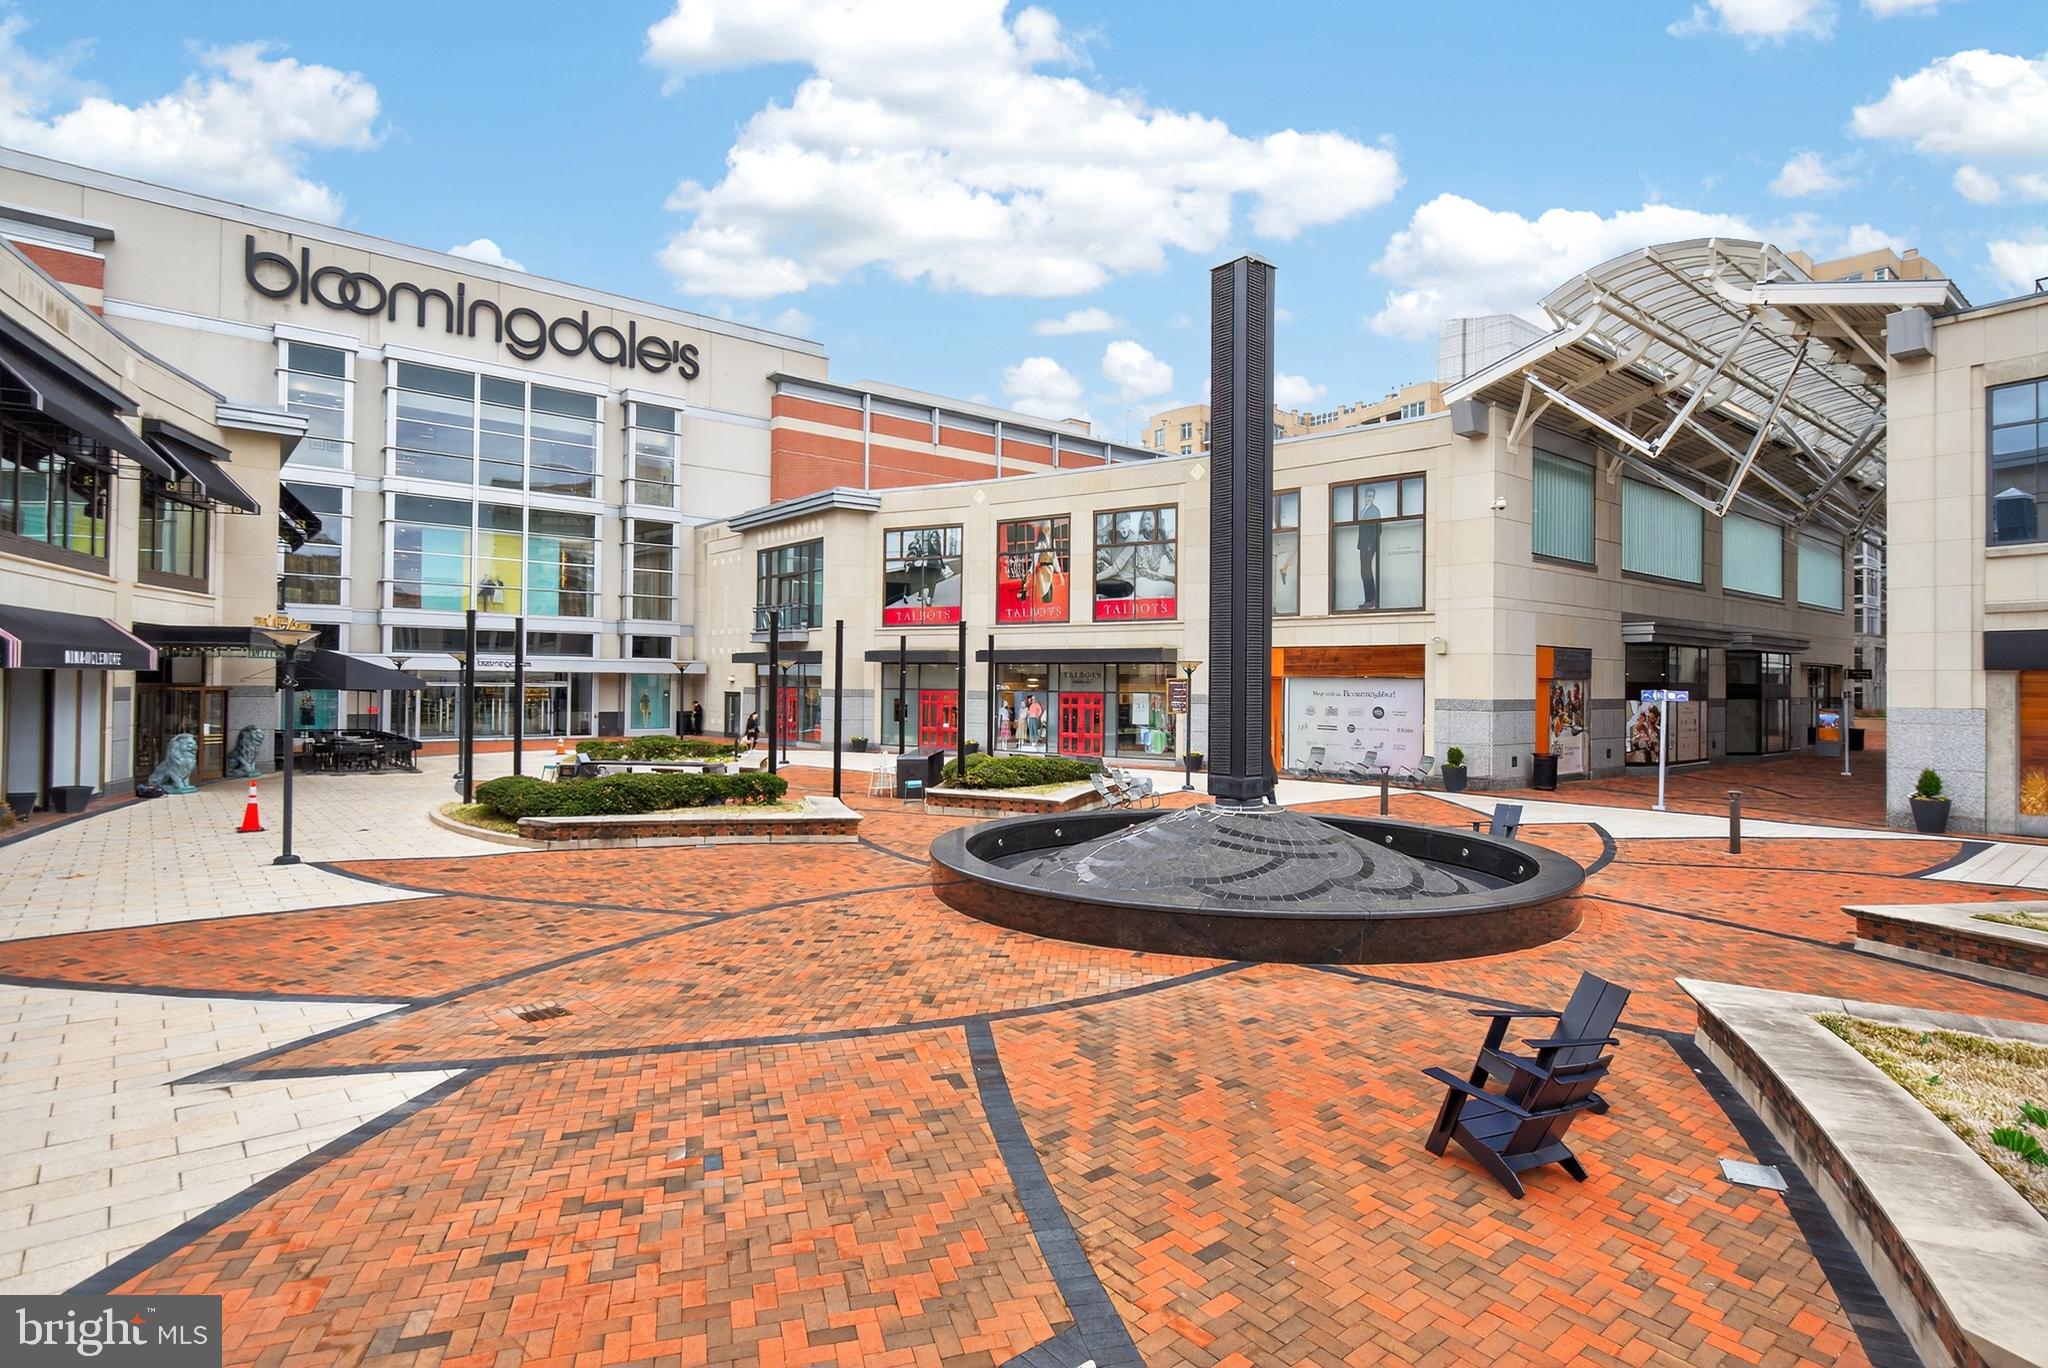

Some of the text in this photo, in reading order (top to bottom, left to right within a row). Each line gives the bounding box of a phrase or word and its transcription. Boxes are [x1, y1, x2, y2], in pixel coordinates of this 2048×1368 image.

[1005, 607, 1062, 618] TALBOTS
[1103, 603, 1168, 615] TALBOTS
[896, 610, 951, 621] TALBOTS
